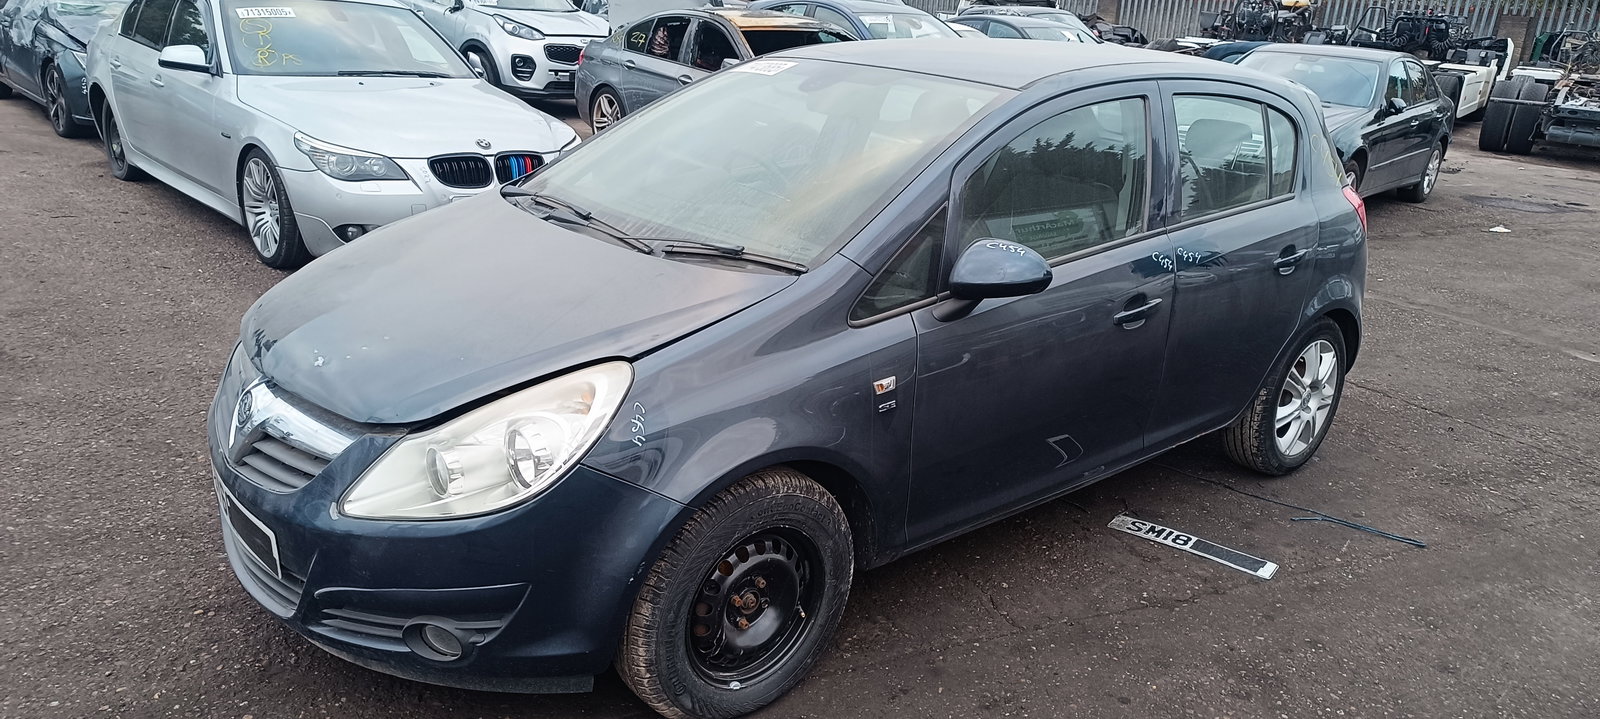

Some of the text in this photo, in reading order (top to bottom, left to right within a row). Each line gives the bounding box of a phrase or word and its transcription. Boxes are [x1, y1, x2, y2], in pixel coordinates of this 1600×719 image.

[986, 242, 1026, 257] C454
[1177, 247, 1202, 264] C454
[1152, 251, 1173, 271] C454
[1126, 520, 1193, 547] SM18
